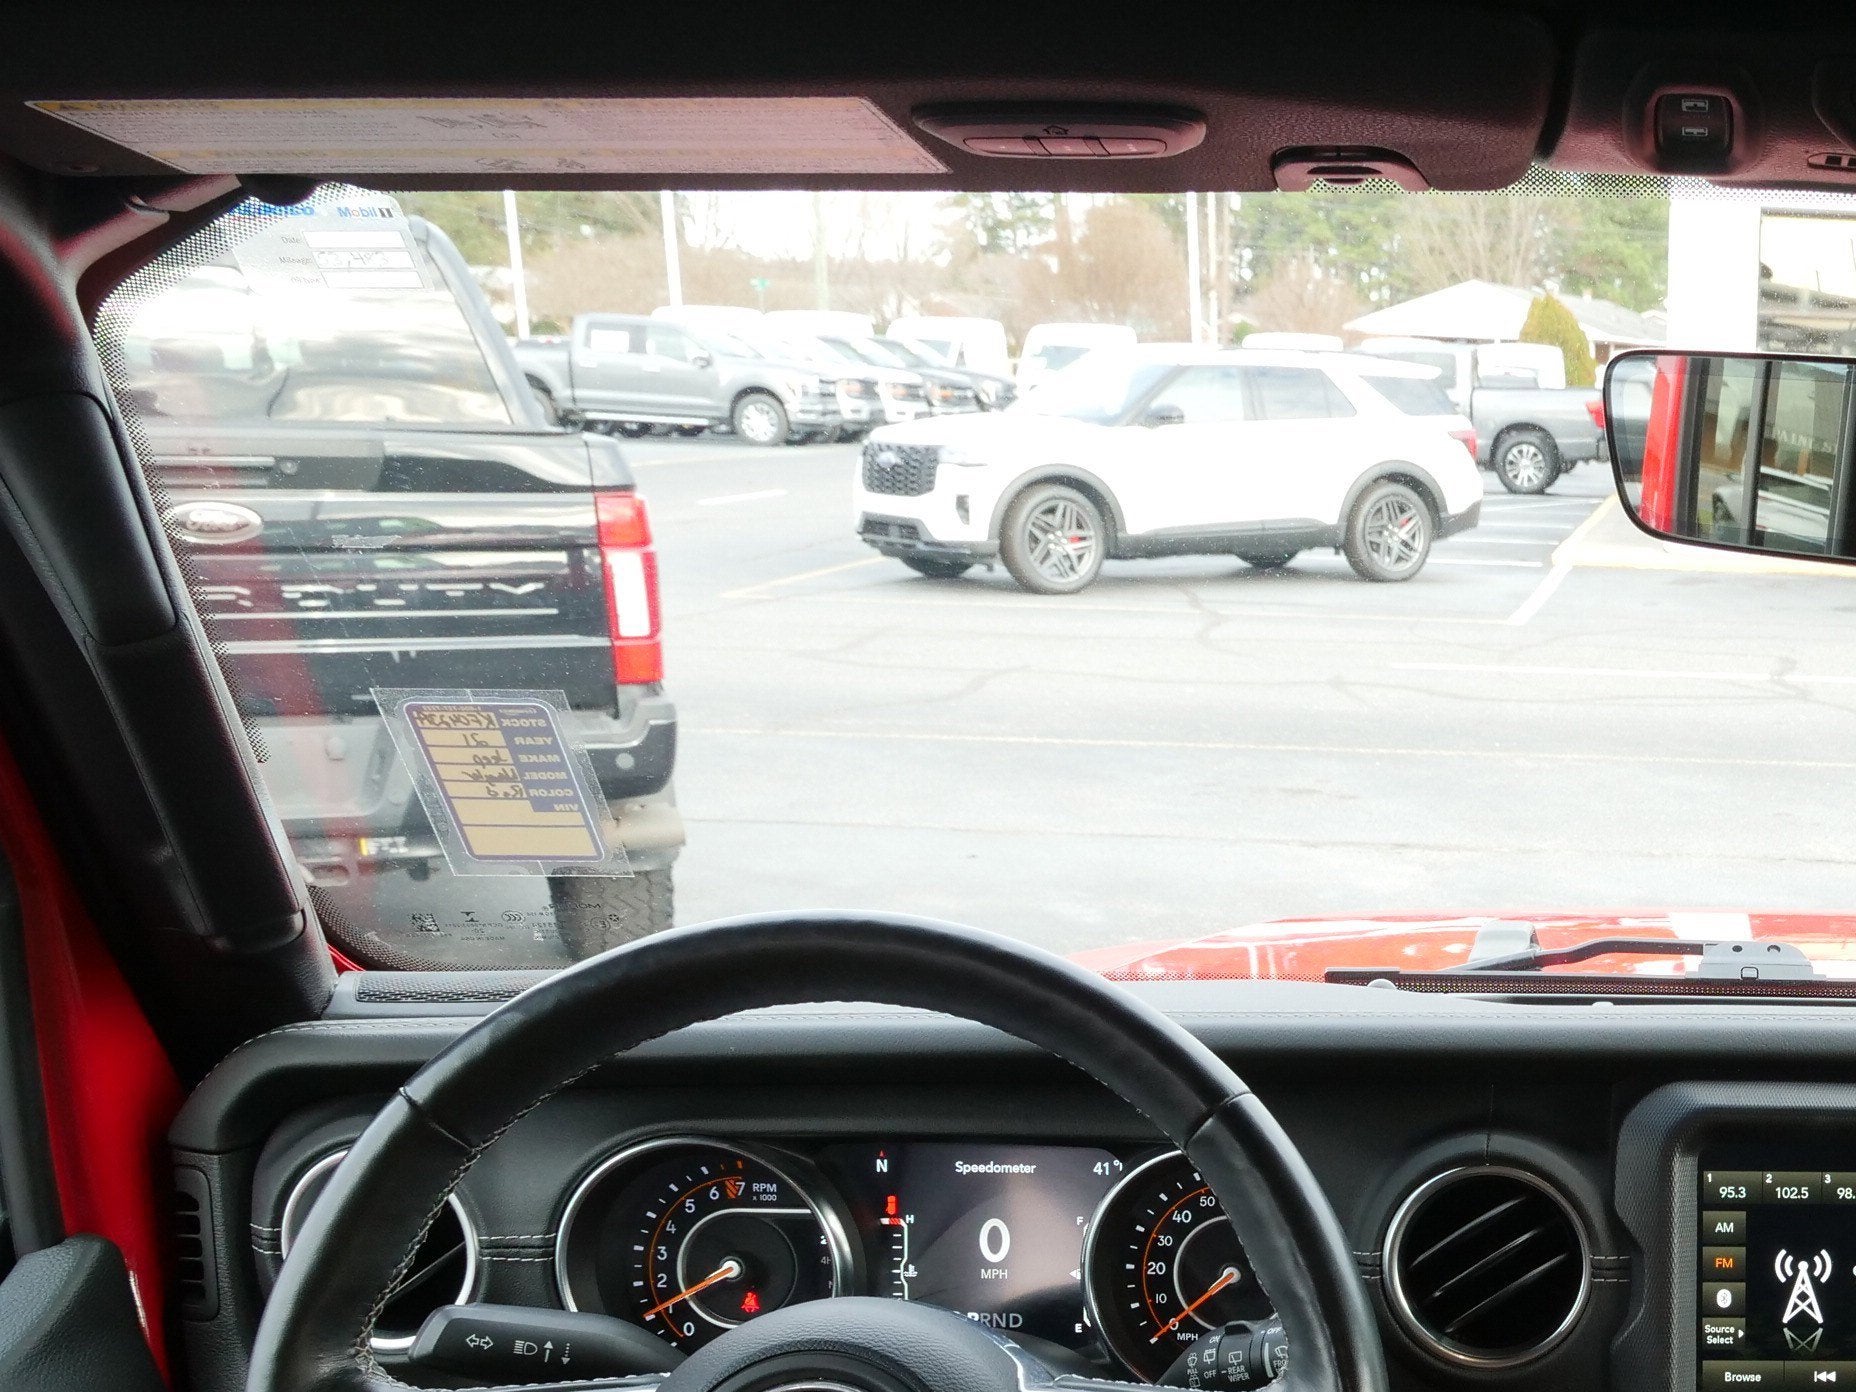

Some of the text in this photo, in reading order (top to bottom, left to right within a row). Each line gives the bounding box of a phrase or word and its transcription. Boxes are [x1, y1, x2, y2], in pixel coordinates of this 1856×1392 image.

[337, 207, 377, 217] Mobil
[876, 1159, 888, 1172] N
[955, 1161, 1036, 1175] Speedometer
[1706, 1174, 1713, 1183] 1
[1765, 1174, 1772, 1184] 2
[1824, 1174, 1831, 1184] 3
[709, 1185, 720, 1200] 6
[736, 1181, 746, 1196] 7
[753, 1183, 777, 1193] RPM
[1719, 1186, 1747, 1200] 95.3
[1775, 1186, 1809, 1200] 102.5
[684, 1198, 696, 1214] 5
[1200, 1195, 1215, 1208] 50
[905, 1214, 914, 1224] H
[1077, 1216, 1083, 1225] F
[1172, 1210, 1191, 1224] 40
[666, 1220, 676, 1235] 4
[1715, 1222, 1734, 1234] AM
[979, 1218, 1010, 1262] 0
[1157, 1234, 1173, 1247] 30
[657, 1245, 668, 1260] 3
[1147, 1261, 1166, 1276] 20
[1716, 1257, 1733, 1269] FM
[981, 1268, 1008, 1280] MPH
[657, 1273, 668, 1288] 2
[1155, 1293, 1167, 1304] 10
[683, 1321, 695, 1336] 0
[1074, 1323, 1083, 1333] E
[1267, 1327, 1282, 1335] OFF
[1704, 1324, 1735, 1335] Source
[1177, 1333, 1199, 1341] MPH
[1706, 1335, 1734, 1345] Select
[1203, 1370, 1217, 1379] OFF
[1227, 1366, 1245, 1375] REAR
[1227, 1373, 1250, 1382] WIPER
[1724, 1371, 1762, 1384] Browse
